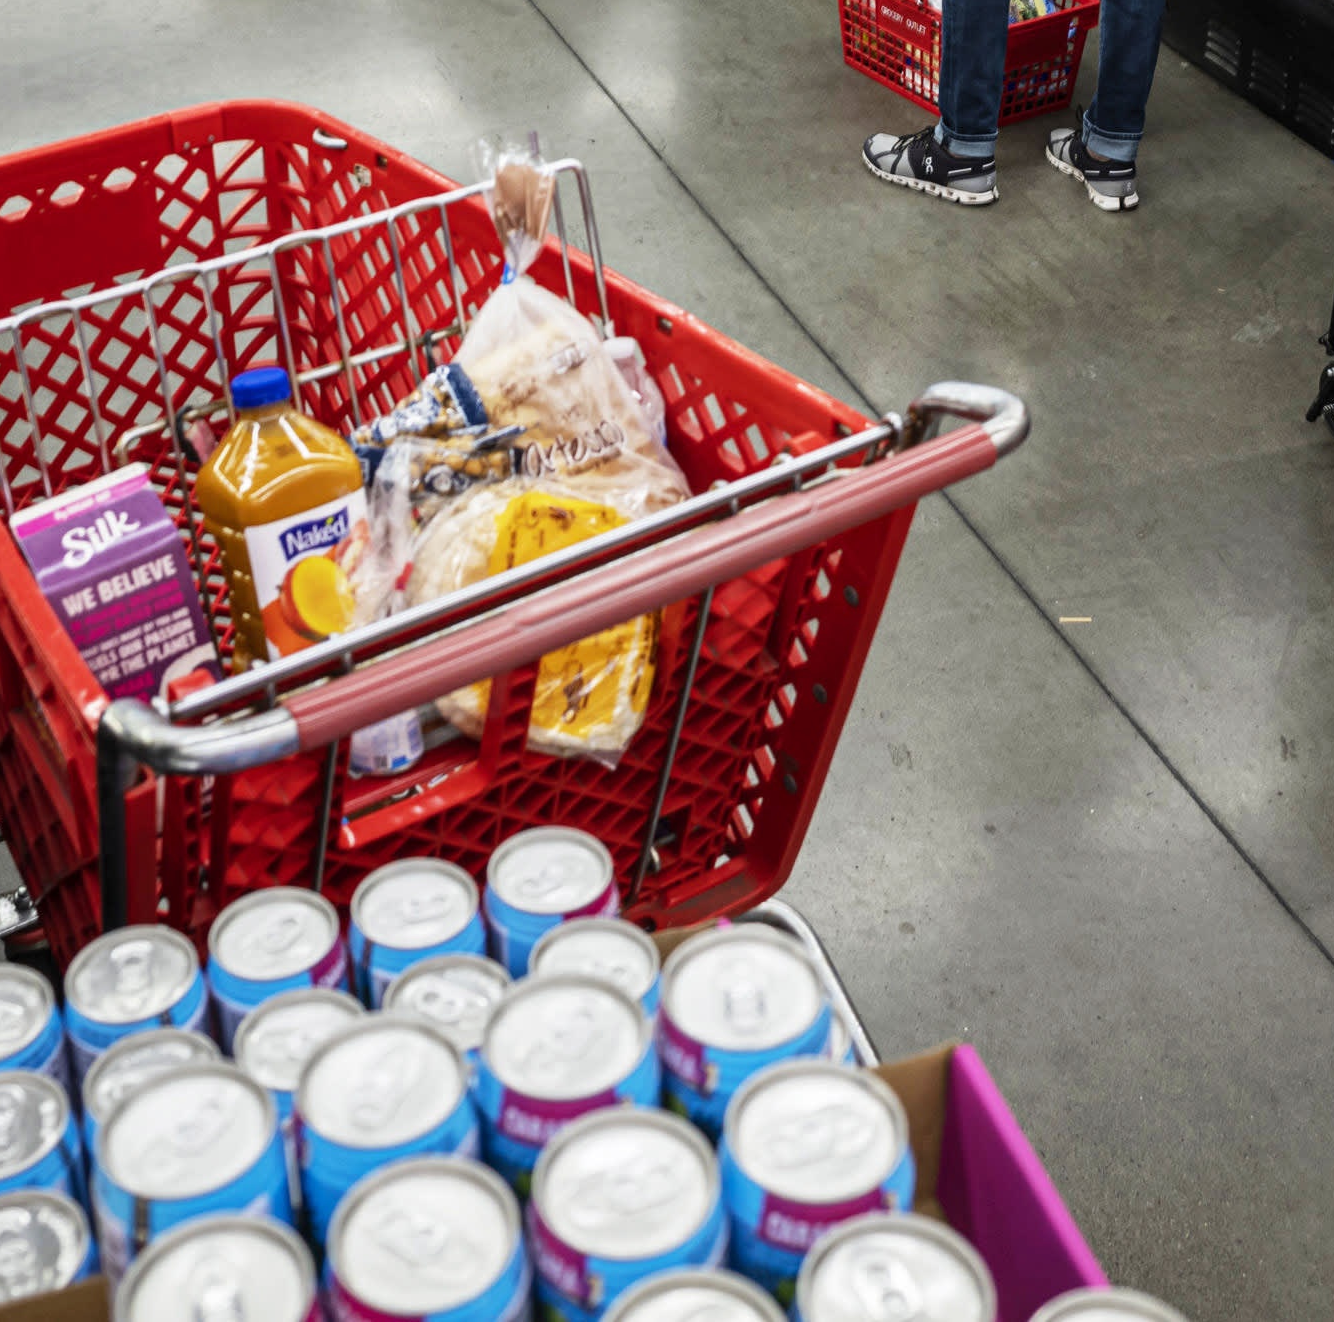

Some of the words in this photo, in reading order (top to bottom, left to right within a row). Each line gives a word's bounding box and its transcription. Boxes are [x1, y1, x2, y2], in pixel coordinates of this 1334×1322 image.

[880, 5, 903, 24] GROCERY
[906, 16, 927, 35] OUTLET
[61, 510, 141, 568] Silk
[285, 515, 347, 555] Naked
[62, 587, 98, 617] WE
[97, 553, 177, 604] BELIEVE
[118, 638, 143, 660] OUR
[144, 617, 193, 646] PASSION
[120, 656, 145, 678] THE
[146, 629, 197, 665] PLANET
